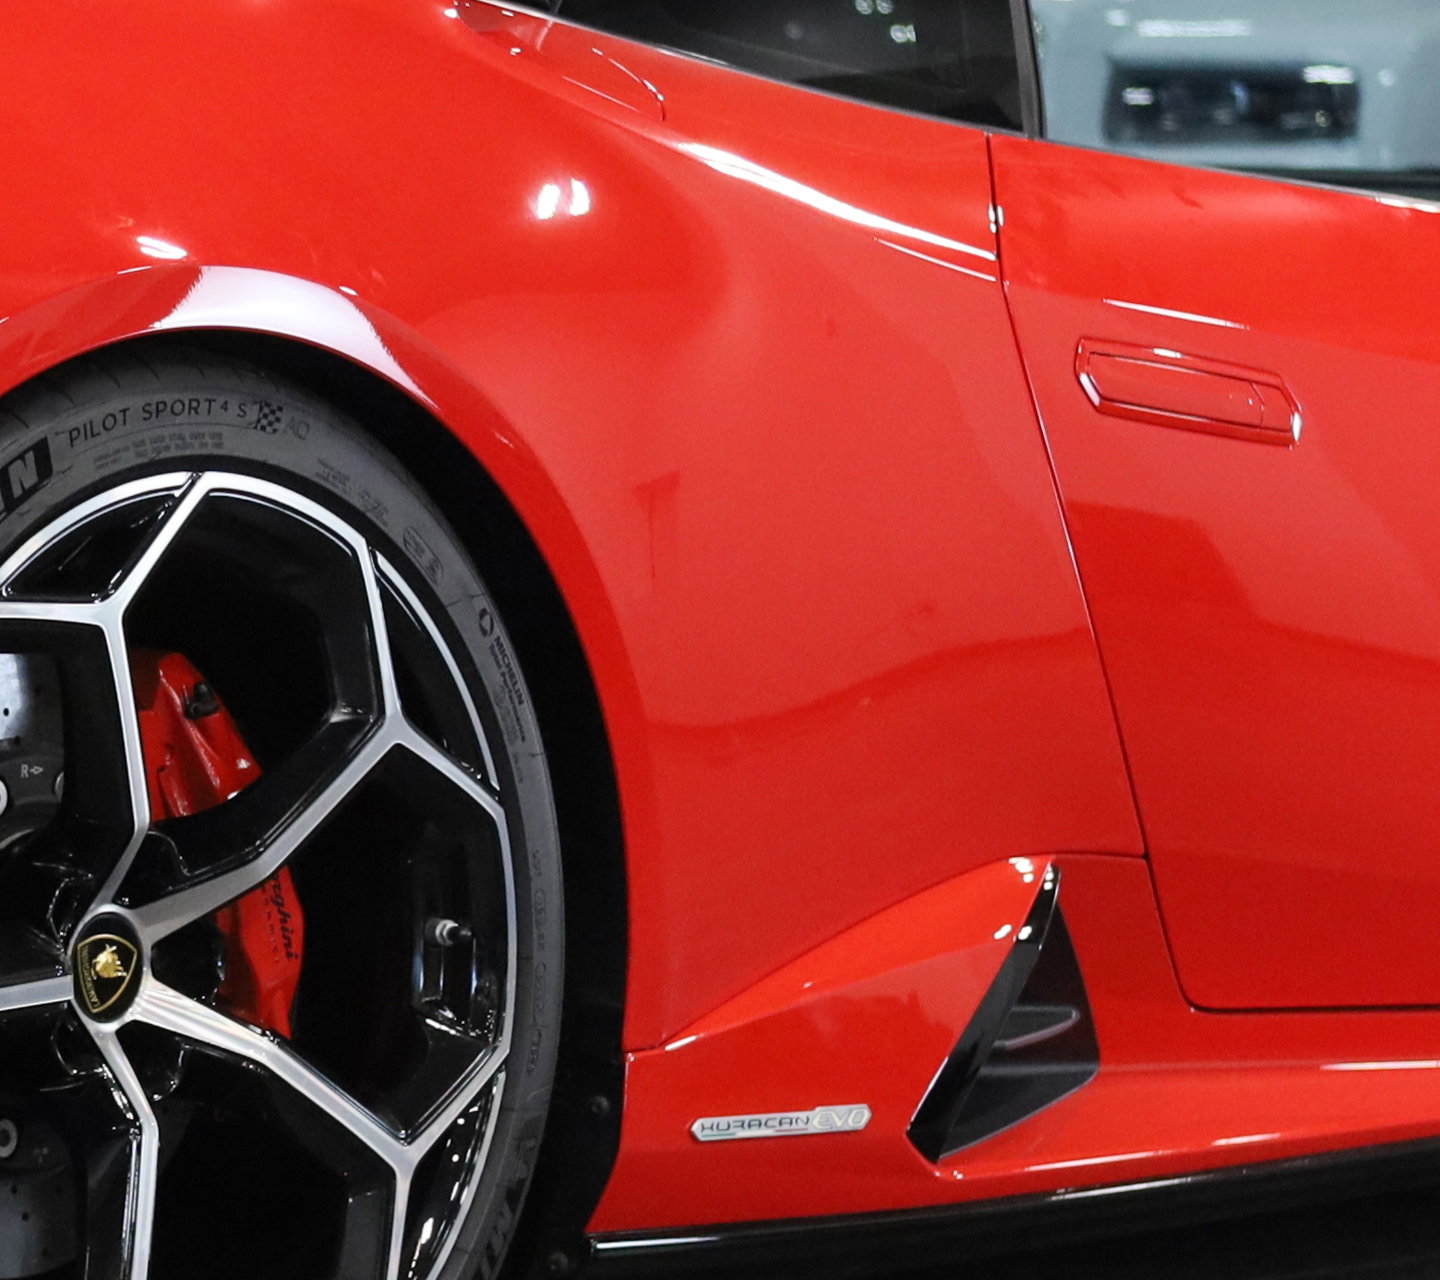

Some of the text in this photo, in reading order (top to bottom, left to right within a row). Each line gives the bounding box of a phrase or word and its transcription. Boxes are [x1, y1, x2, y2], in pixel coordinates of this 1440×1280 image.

[68, 398, 248, 448] PILOT SPORT 4 S
[493, 634, 525, 707] MICHELIN
[812, 1107, 869, 1130] EVO
